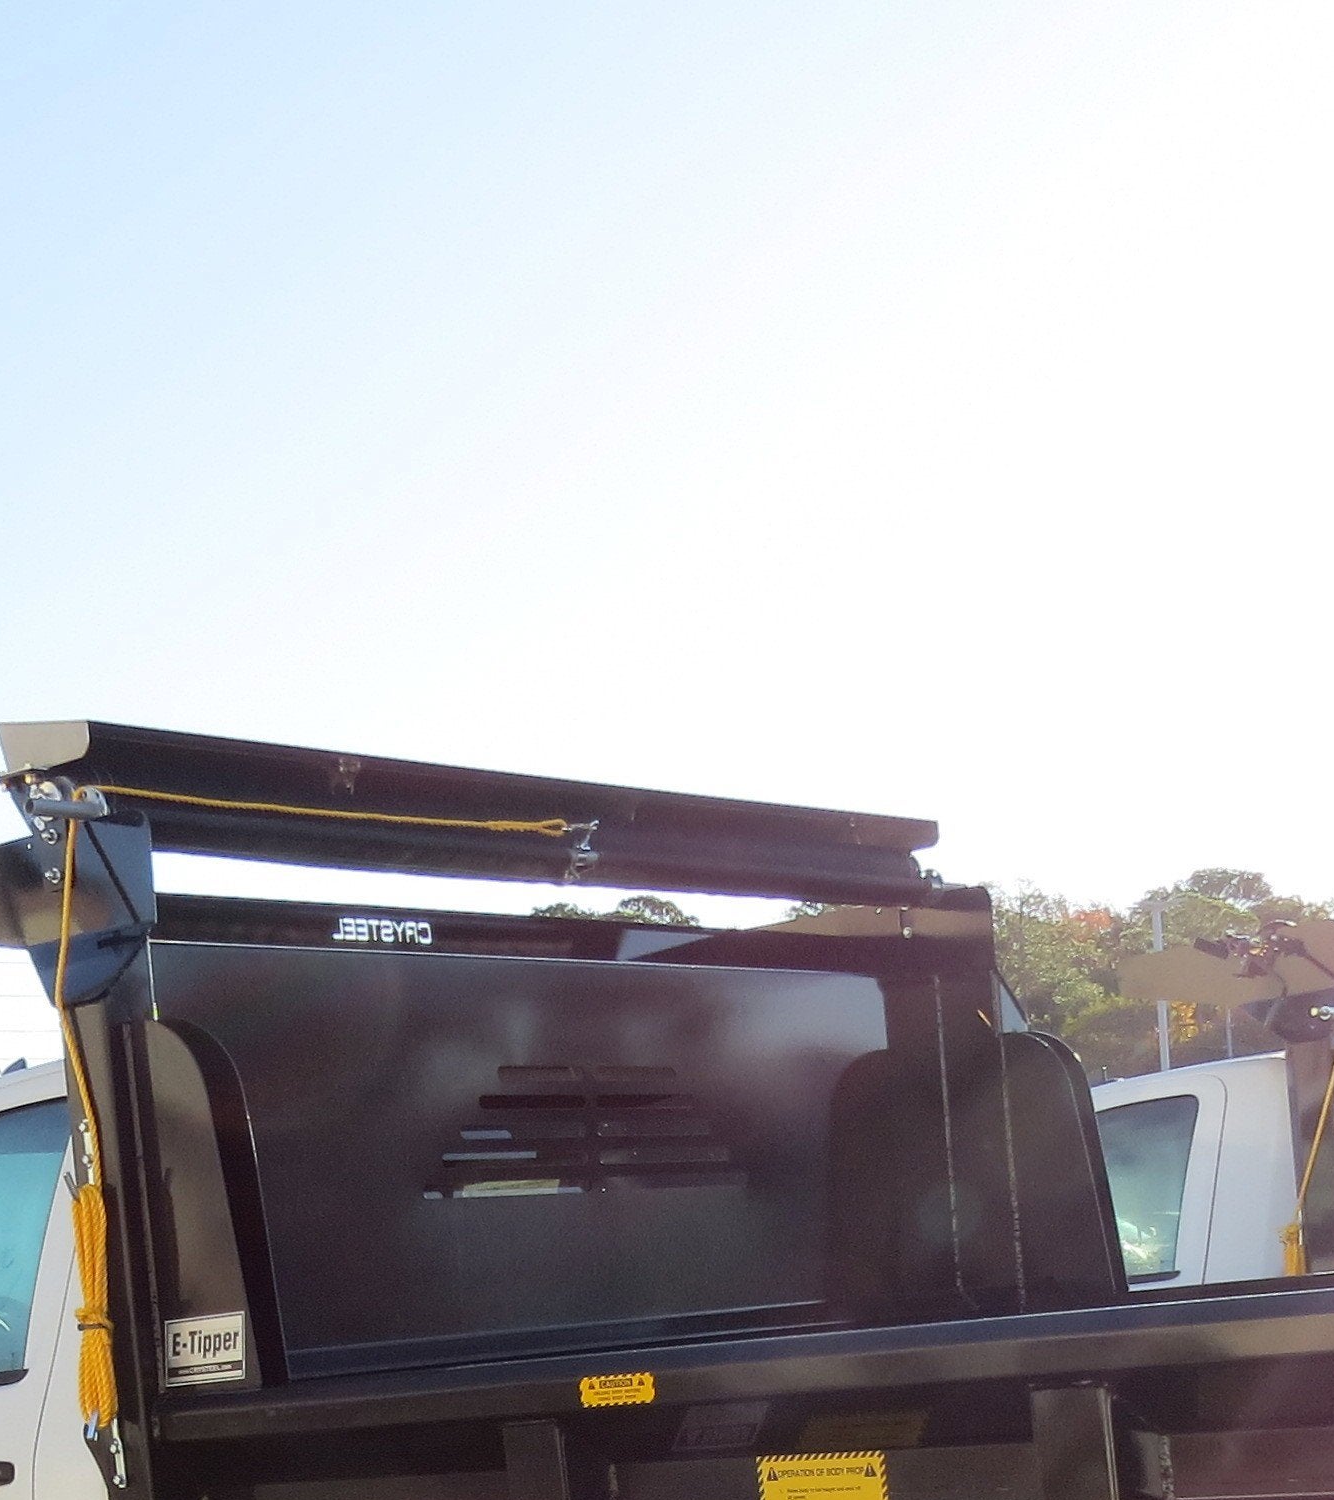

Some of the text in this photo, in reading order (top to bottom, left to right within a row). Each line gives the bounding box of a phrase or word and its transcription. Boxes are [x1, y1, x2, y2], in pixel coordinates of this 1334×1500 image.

[172, 1329, 240, 1359] E-Tipper
[778, 1466, 864, 1479] OPERATION OF BODY PROP
